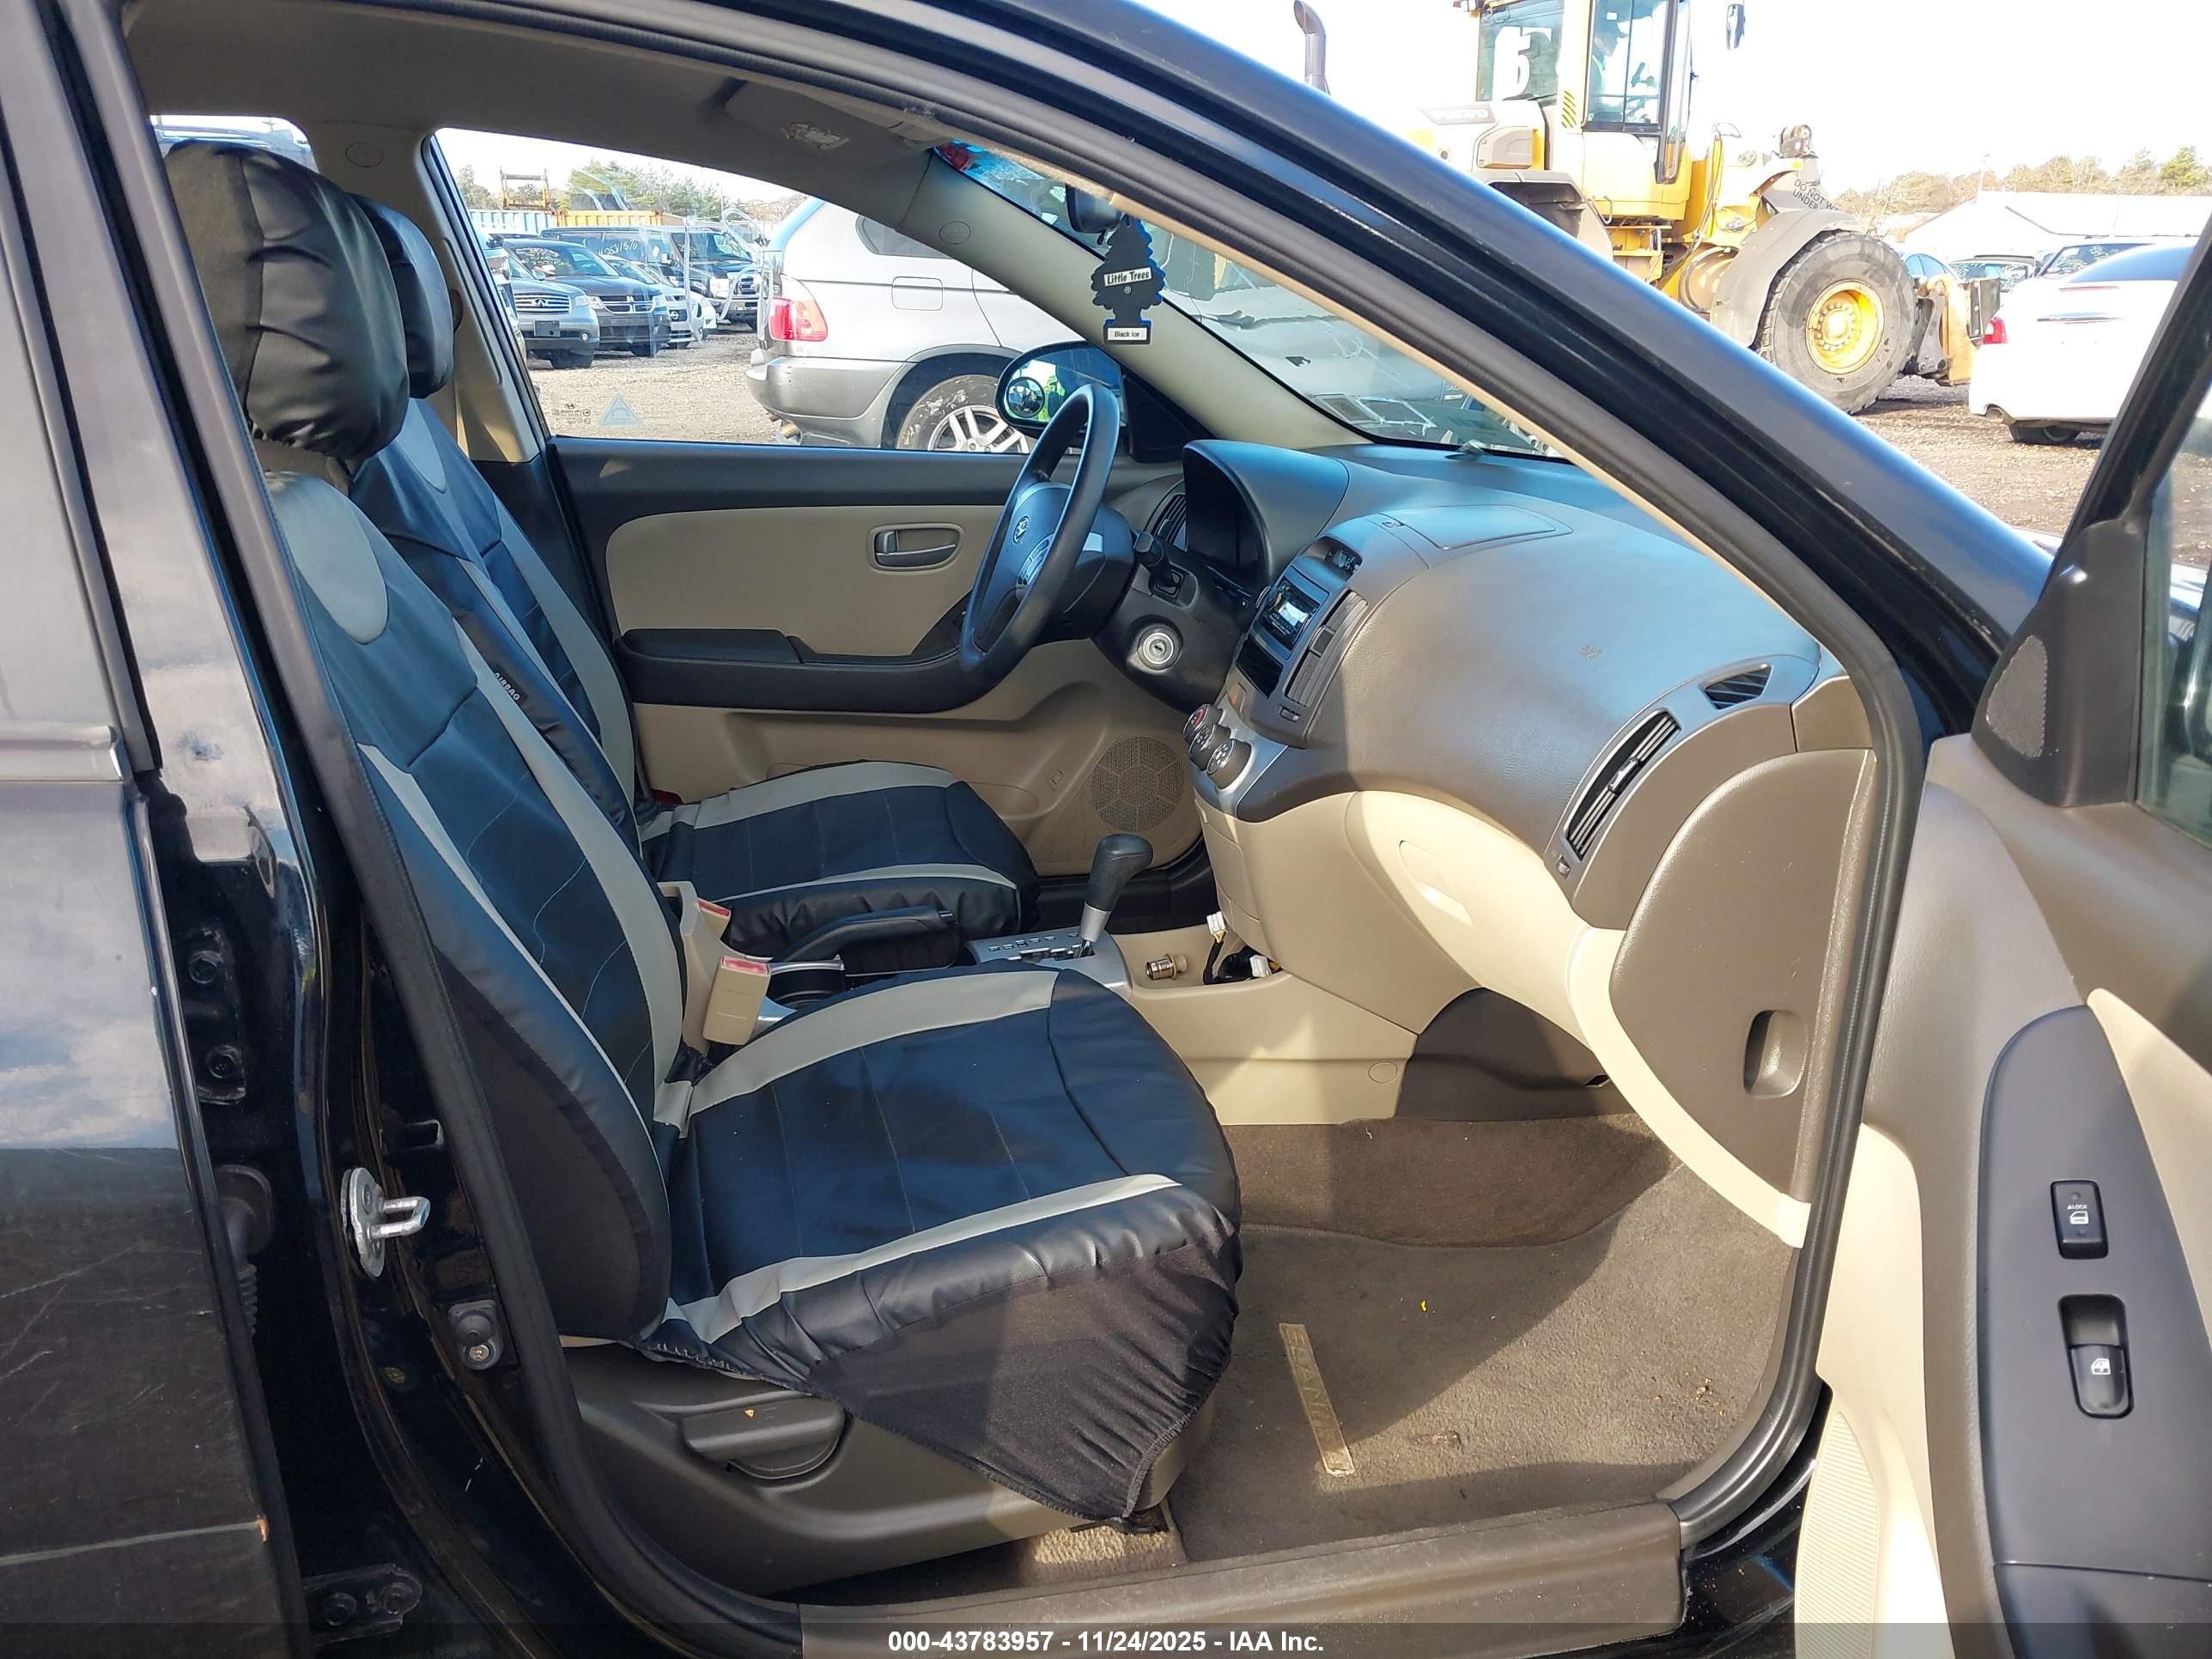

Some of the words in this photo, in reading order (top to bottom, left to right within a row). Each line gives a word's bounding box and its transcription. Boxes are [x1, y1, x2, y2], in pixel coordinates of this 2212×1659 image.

[1793, 189, 1818, 210] UNDER
[1795, 179, 1807, 191] DO
[1808, 188, 1825, 204] NOT
[1108, 273, 1127, 284] Little
[1129, 271, 1149, 282] Trees
